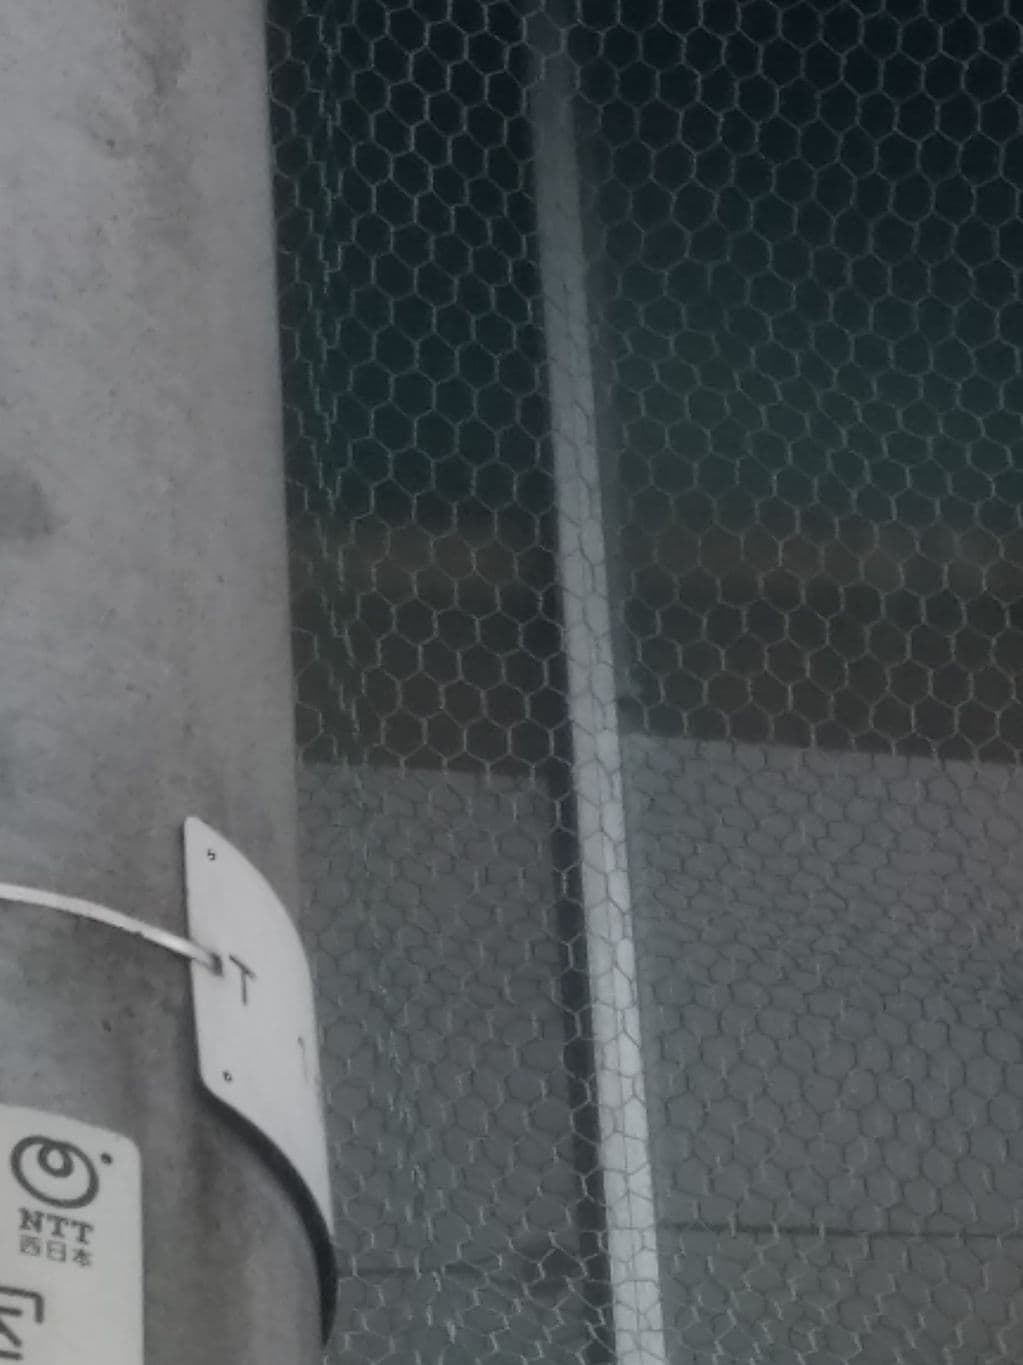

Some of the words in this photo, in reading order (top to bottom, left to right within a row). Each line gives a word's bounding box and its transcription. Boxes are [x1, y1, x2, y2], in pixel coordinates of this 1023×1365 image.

[18, 1207, 94, 1245] NTT
[18, 1234, 93, 1267] 西日本
